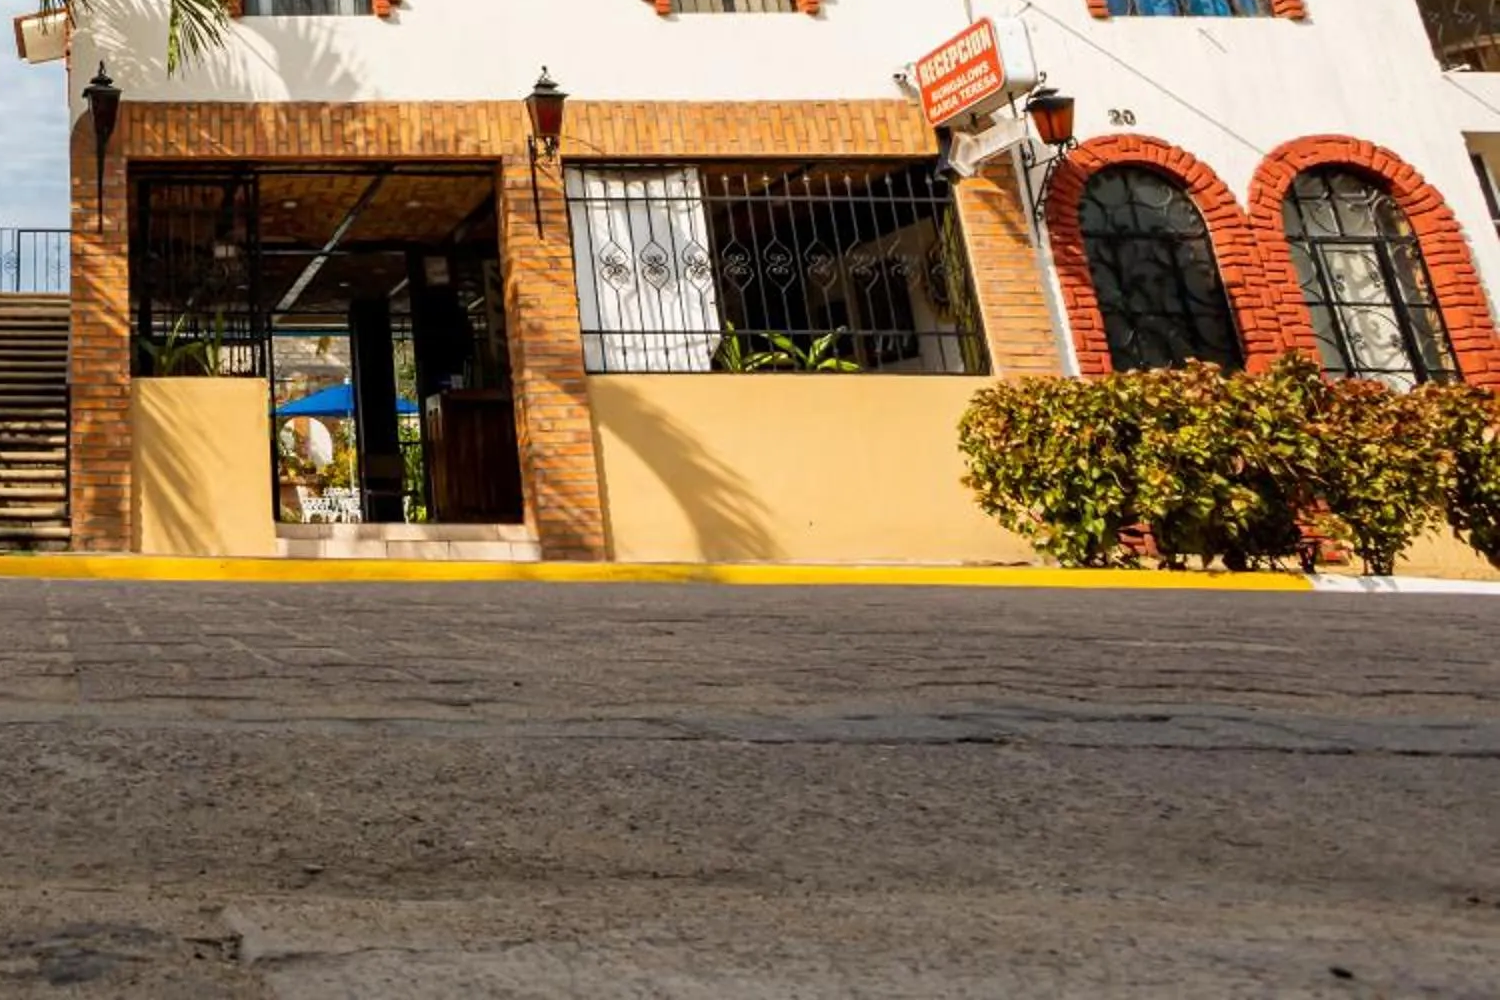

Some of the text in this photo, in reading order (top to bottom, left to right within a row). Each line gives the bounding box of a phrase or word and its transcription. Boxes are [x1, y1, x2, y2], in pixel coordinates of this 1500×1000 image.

[919, 23, 993, 87] RECEPCION
[931, 60, 990, 102] BUNGALOWS
[1107, 109, 1136, 126] 20
